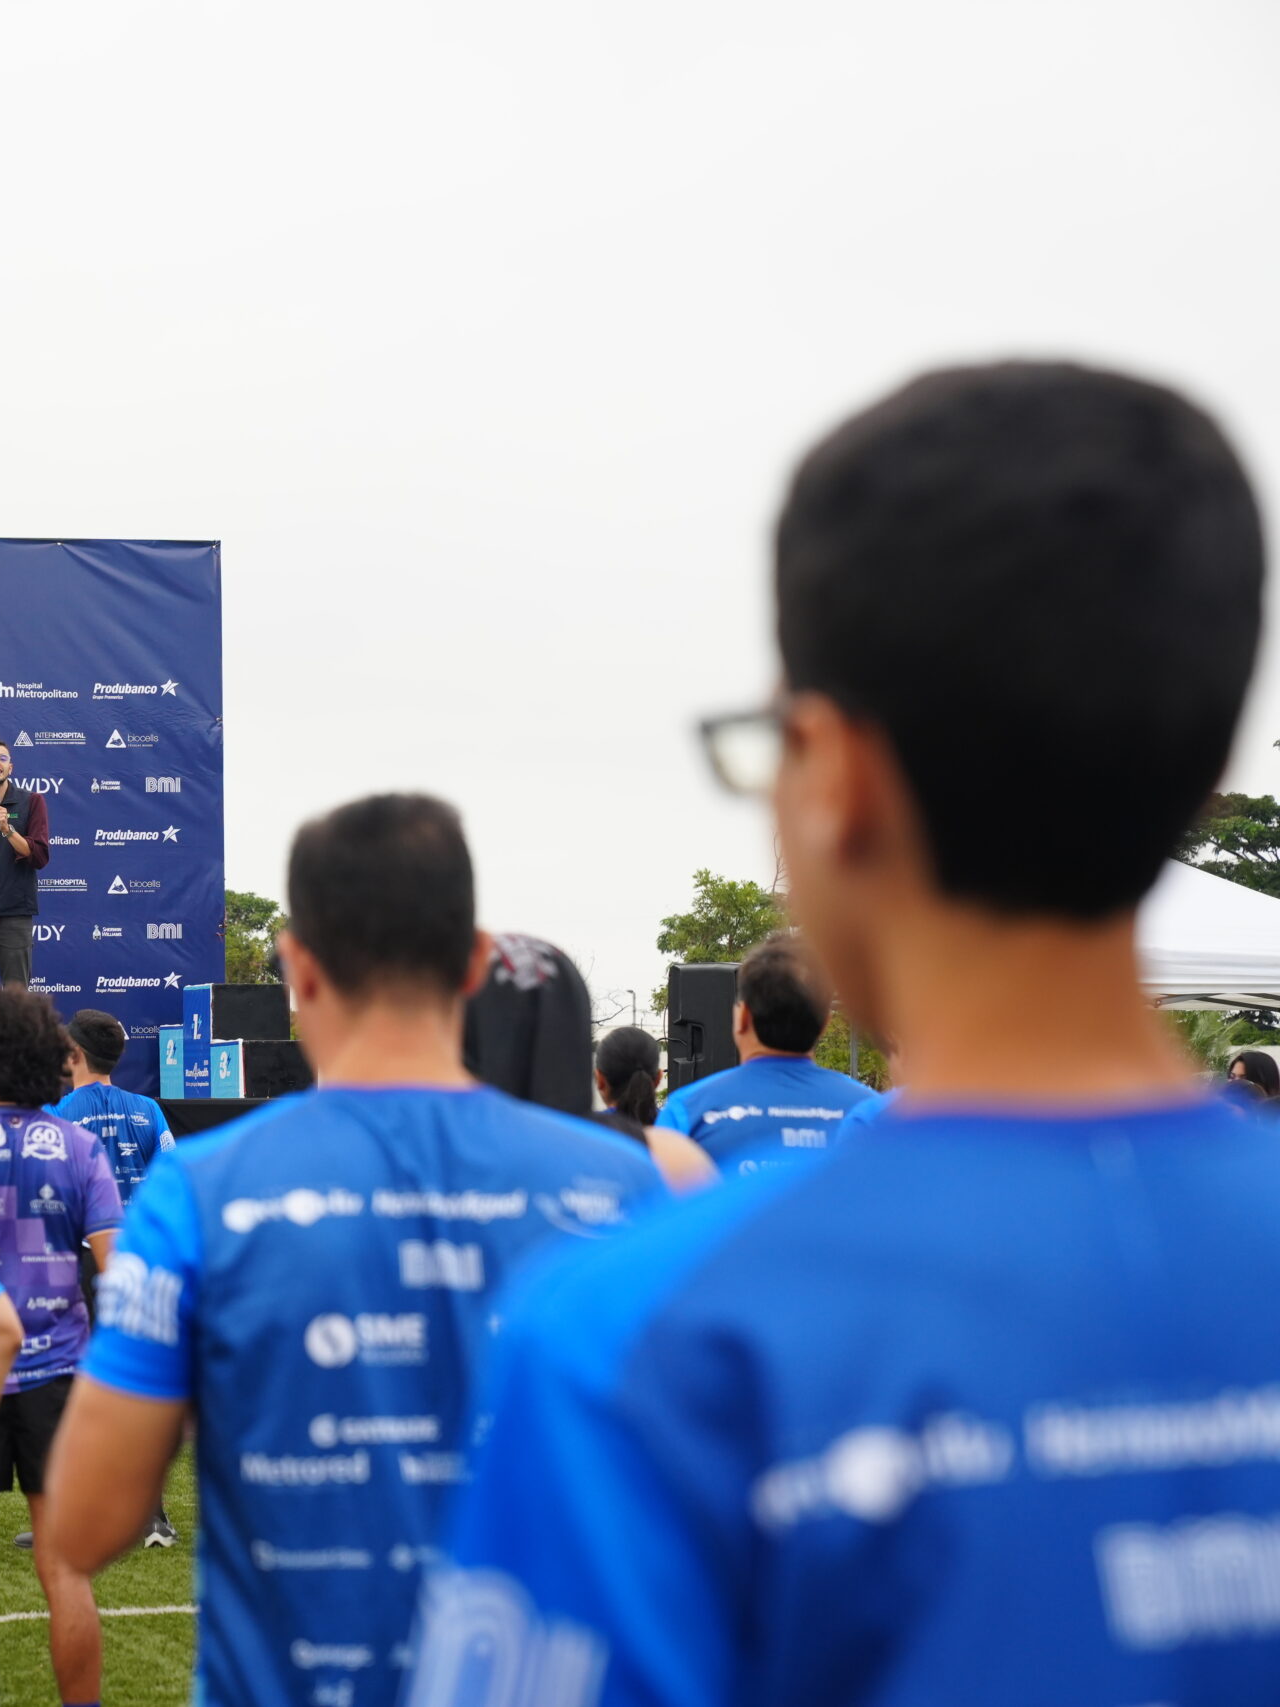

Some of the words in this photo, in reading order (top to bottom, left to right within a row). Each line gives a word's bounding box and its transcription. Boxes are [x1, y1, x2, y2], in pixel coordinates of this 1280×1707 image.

[16, 682, 42, 690] Hospital
[93, 683, 157, 695] Produbanco
[16, 690, 78, 700] Metropolitano
[128, 734, 159, 743] biocells
[145, 777, 181, 793] BMI
[48, 836, 80, 845] olitano
[95, 830, 159, 841] Produbanco
[130, 880, 161, 888] biocells
[146, 923, 183, 939] BMI
[97, 976, 160, 988] Produbanco
[28, 984, 81, 994] etropolitano
[31, 1128, 57, 1144] 60
